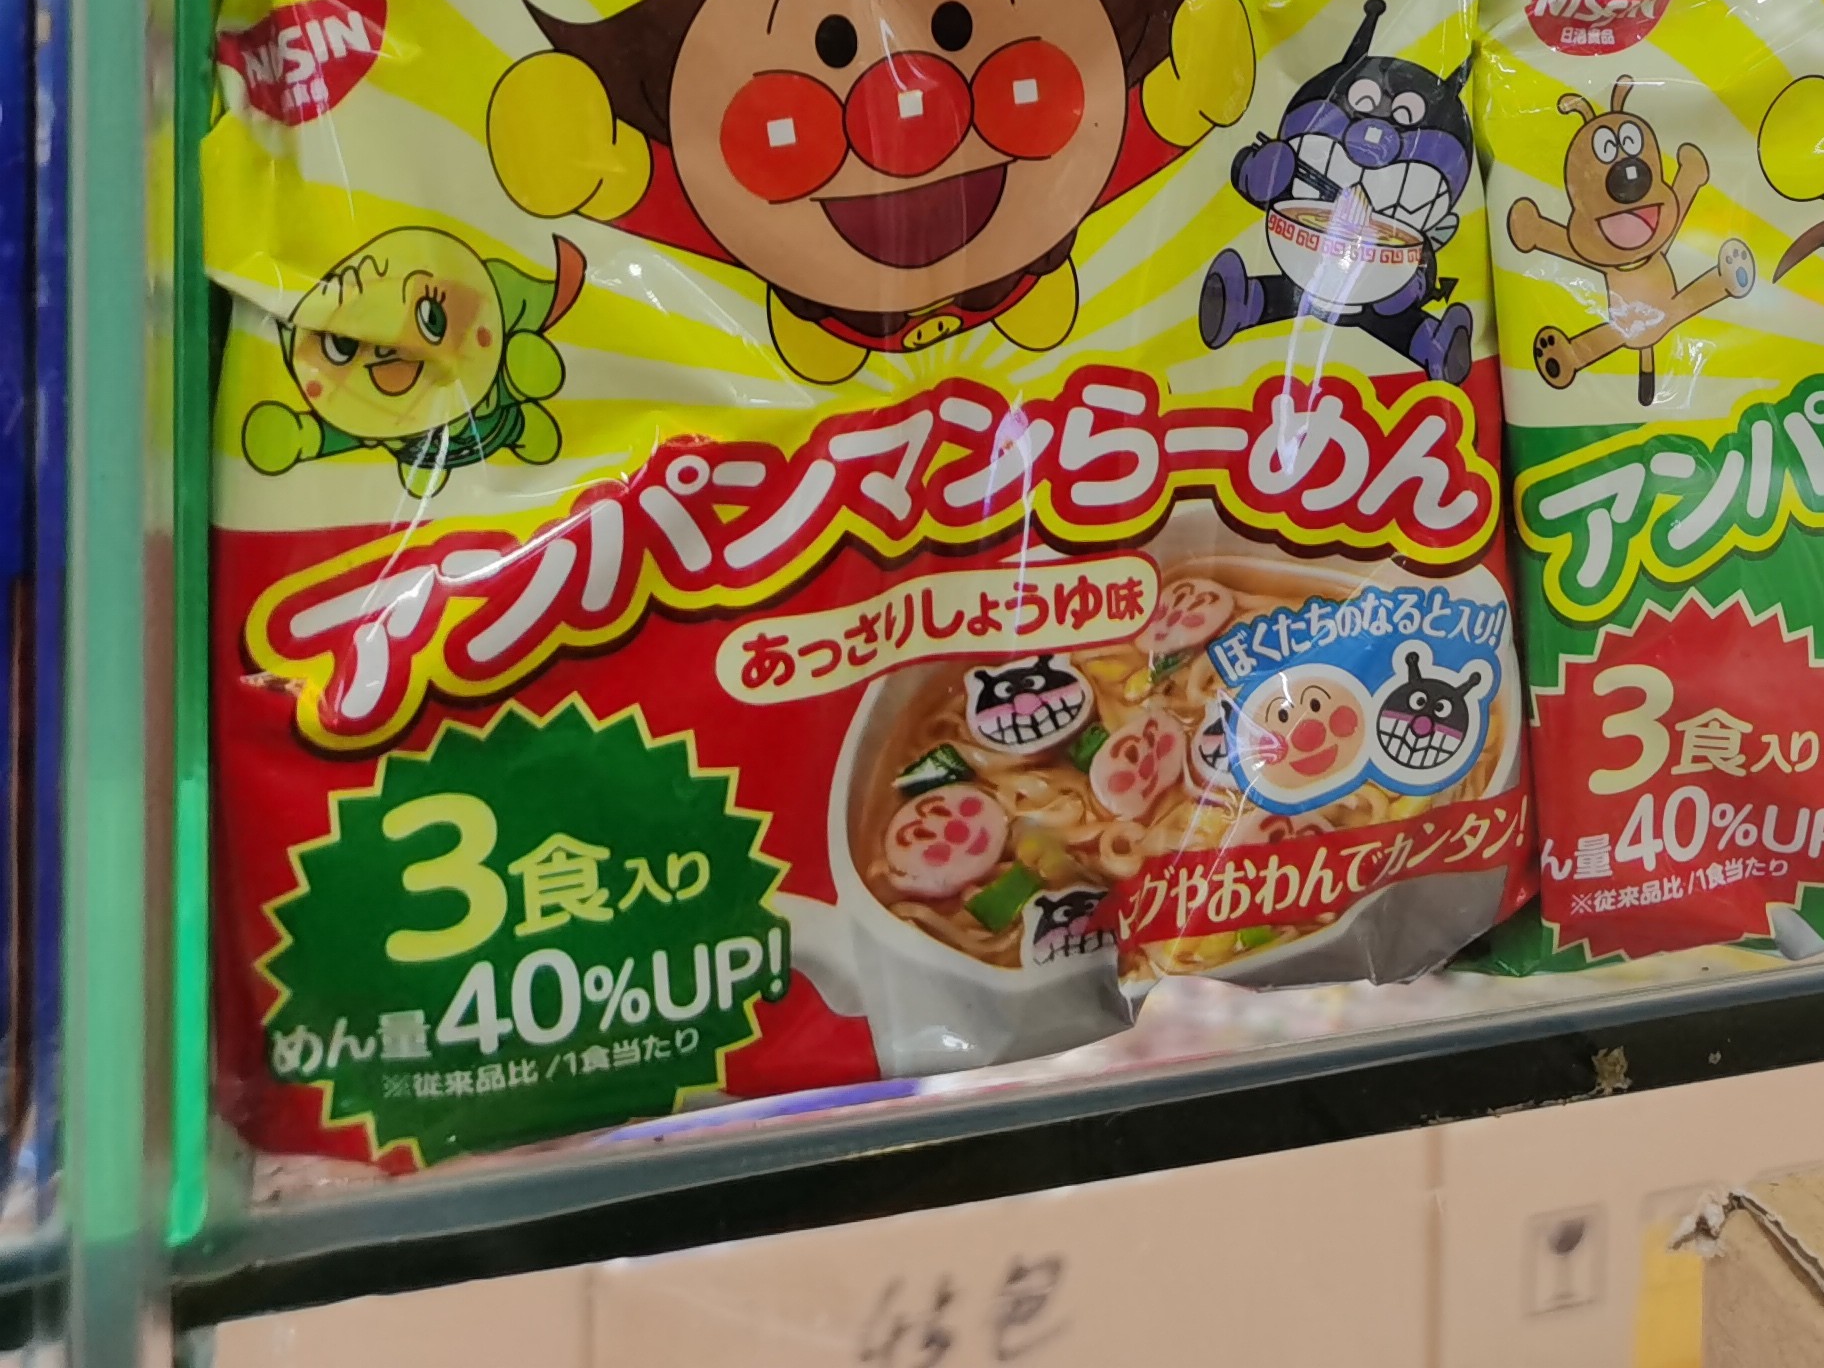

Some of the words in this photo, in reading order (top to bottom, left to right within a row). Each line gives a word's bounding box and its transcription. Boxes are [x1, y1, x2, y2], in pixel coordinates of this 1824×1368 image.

[288, 382, 1480, 720] アンパンマンらーめん
[740, 574, 1146, 689] あっさりしょうゆ味
[1588, 663, 1819, 796] 3食入り
[381, 792, 711, 963] 3食入り
[271, 927, 785, 1076] めん量40%UP!
